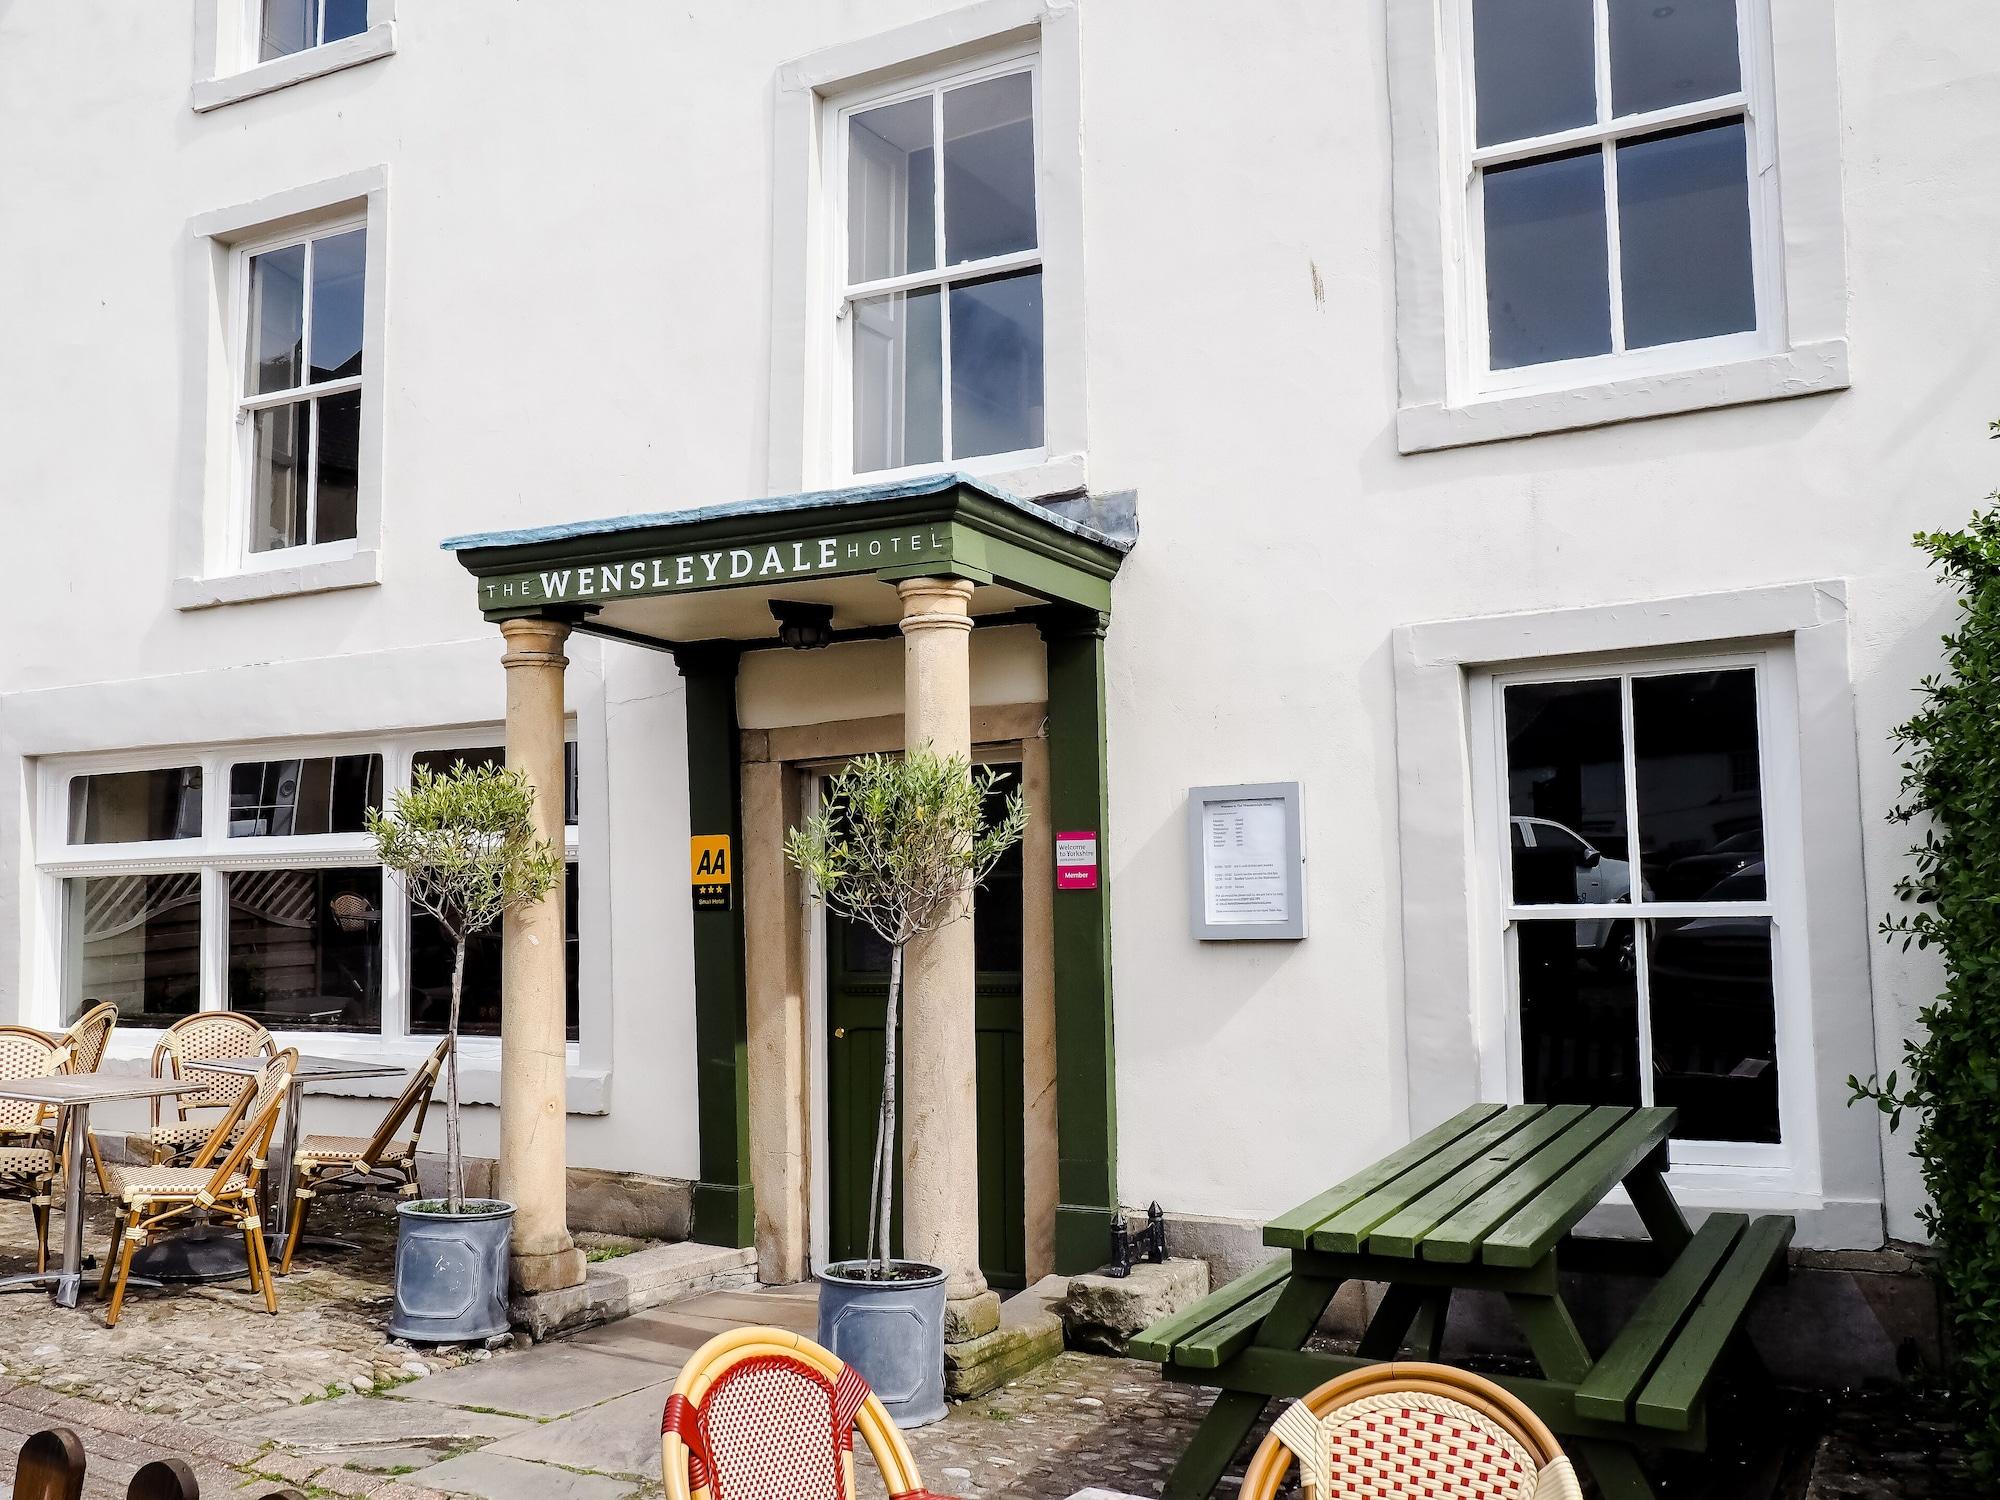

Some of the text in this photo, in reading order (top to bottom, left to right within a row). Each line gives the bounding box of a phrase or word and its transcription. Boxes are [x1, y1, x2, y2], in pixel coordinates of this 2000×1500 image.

[486, 533, 943, 599] THE WENSLEYDALE HOTEL
[696, 848, 726, 875] AA
